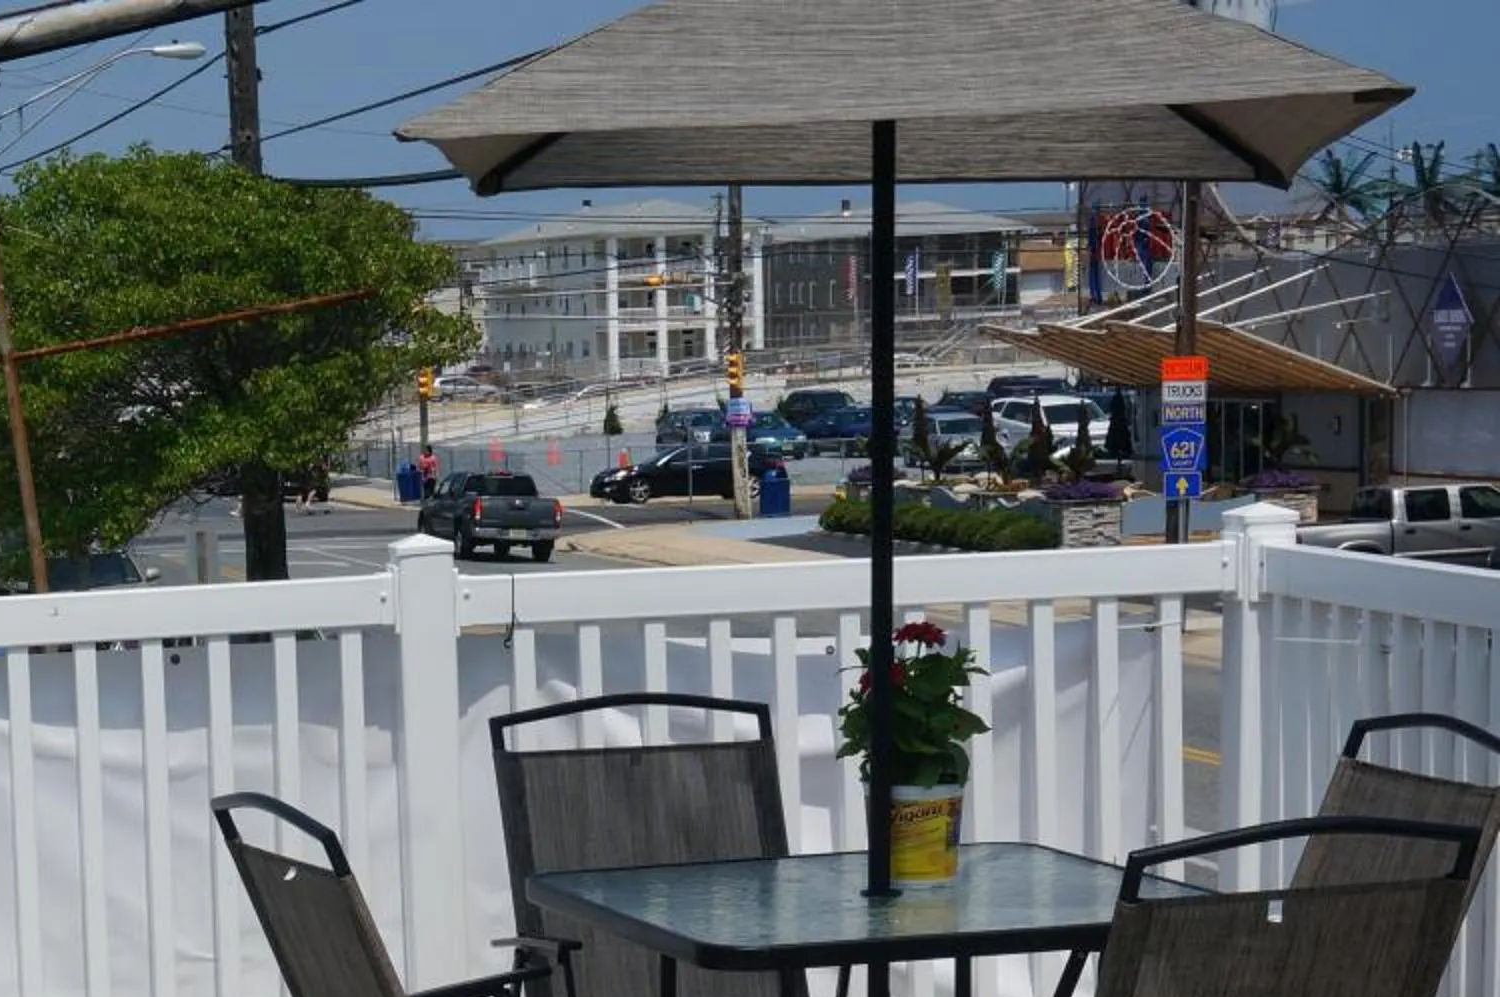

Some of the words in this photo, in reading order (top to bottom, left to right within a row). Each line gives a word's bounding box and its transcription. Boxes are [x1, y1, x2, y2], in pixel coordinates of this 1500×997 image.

[1165, 384, 1203, 399] TRUCKS
[1165, 407, 1204, 420] NORTH
[1171, 441, 1195, 459] 621
